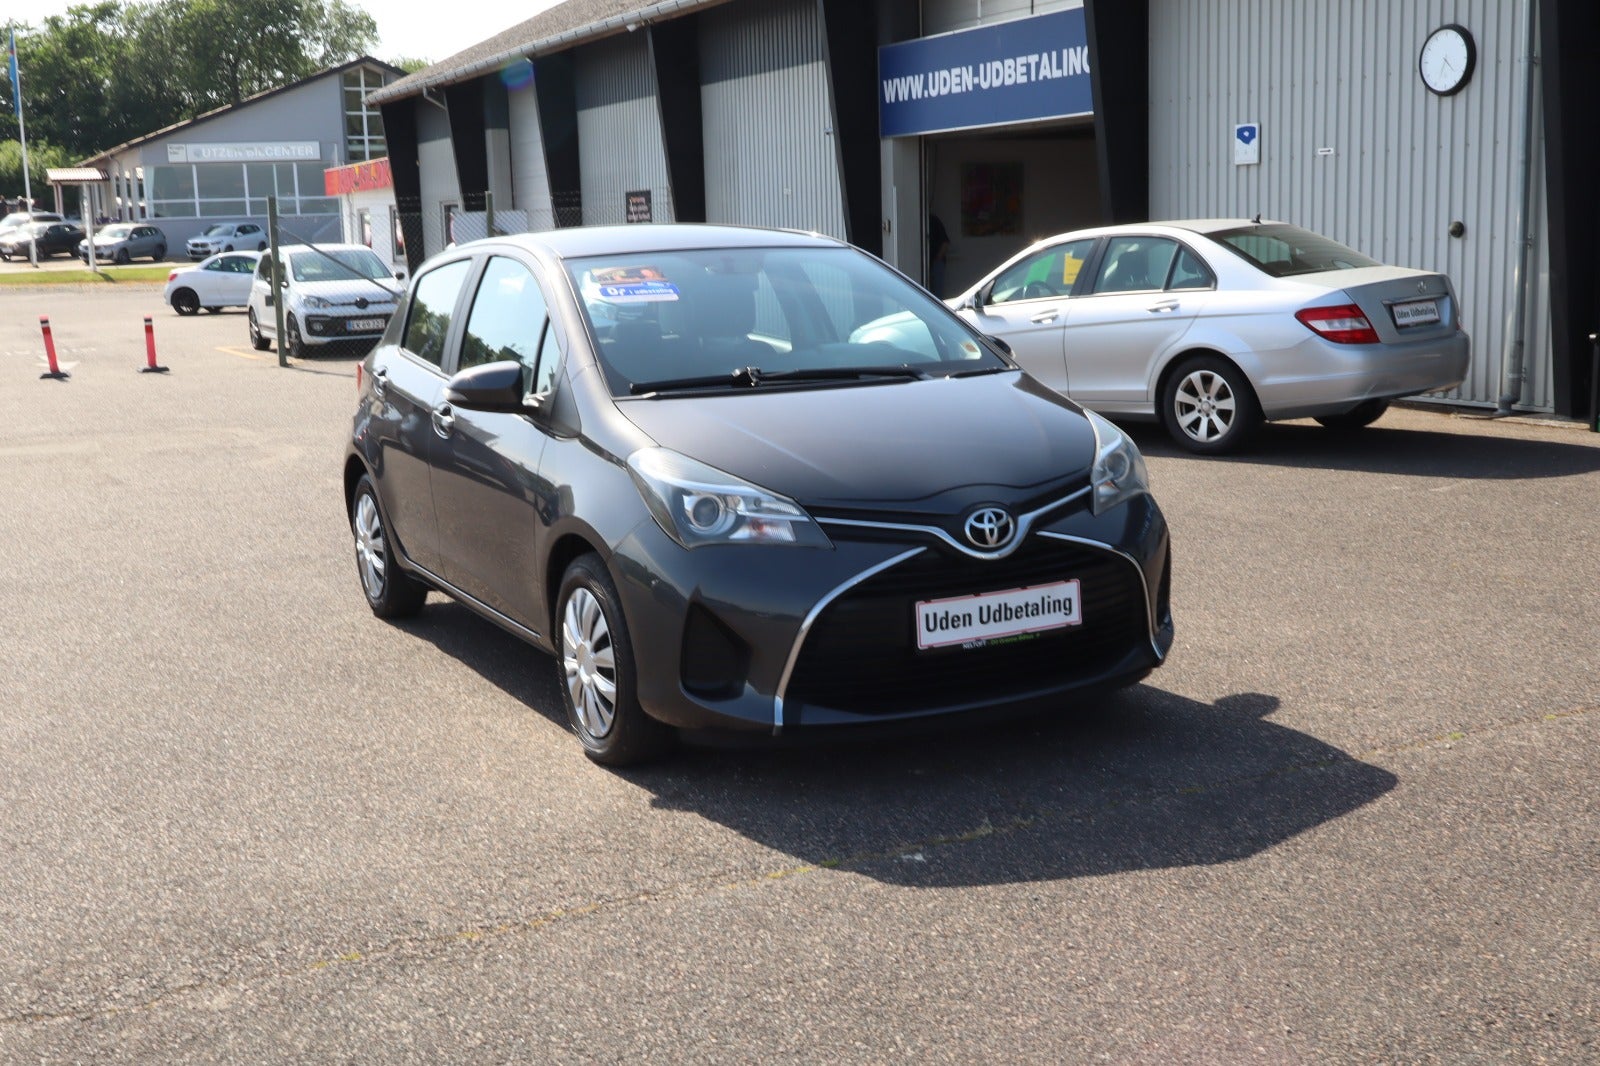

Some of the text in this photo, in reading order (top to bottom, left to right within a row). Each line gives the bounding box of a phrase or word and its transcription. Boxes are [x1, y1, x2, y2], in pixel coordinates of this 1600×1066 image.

[1397, 306, 1437, 319] Uden Udbetaling
[925, 595, 1073, 632] Uden Udbetaling
